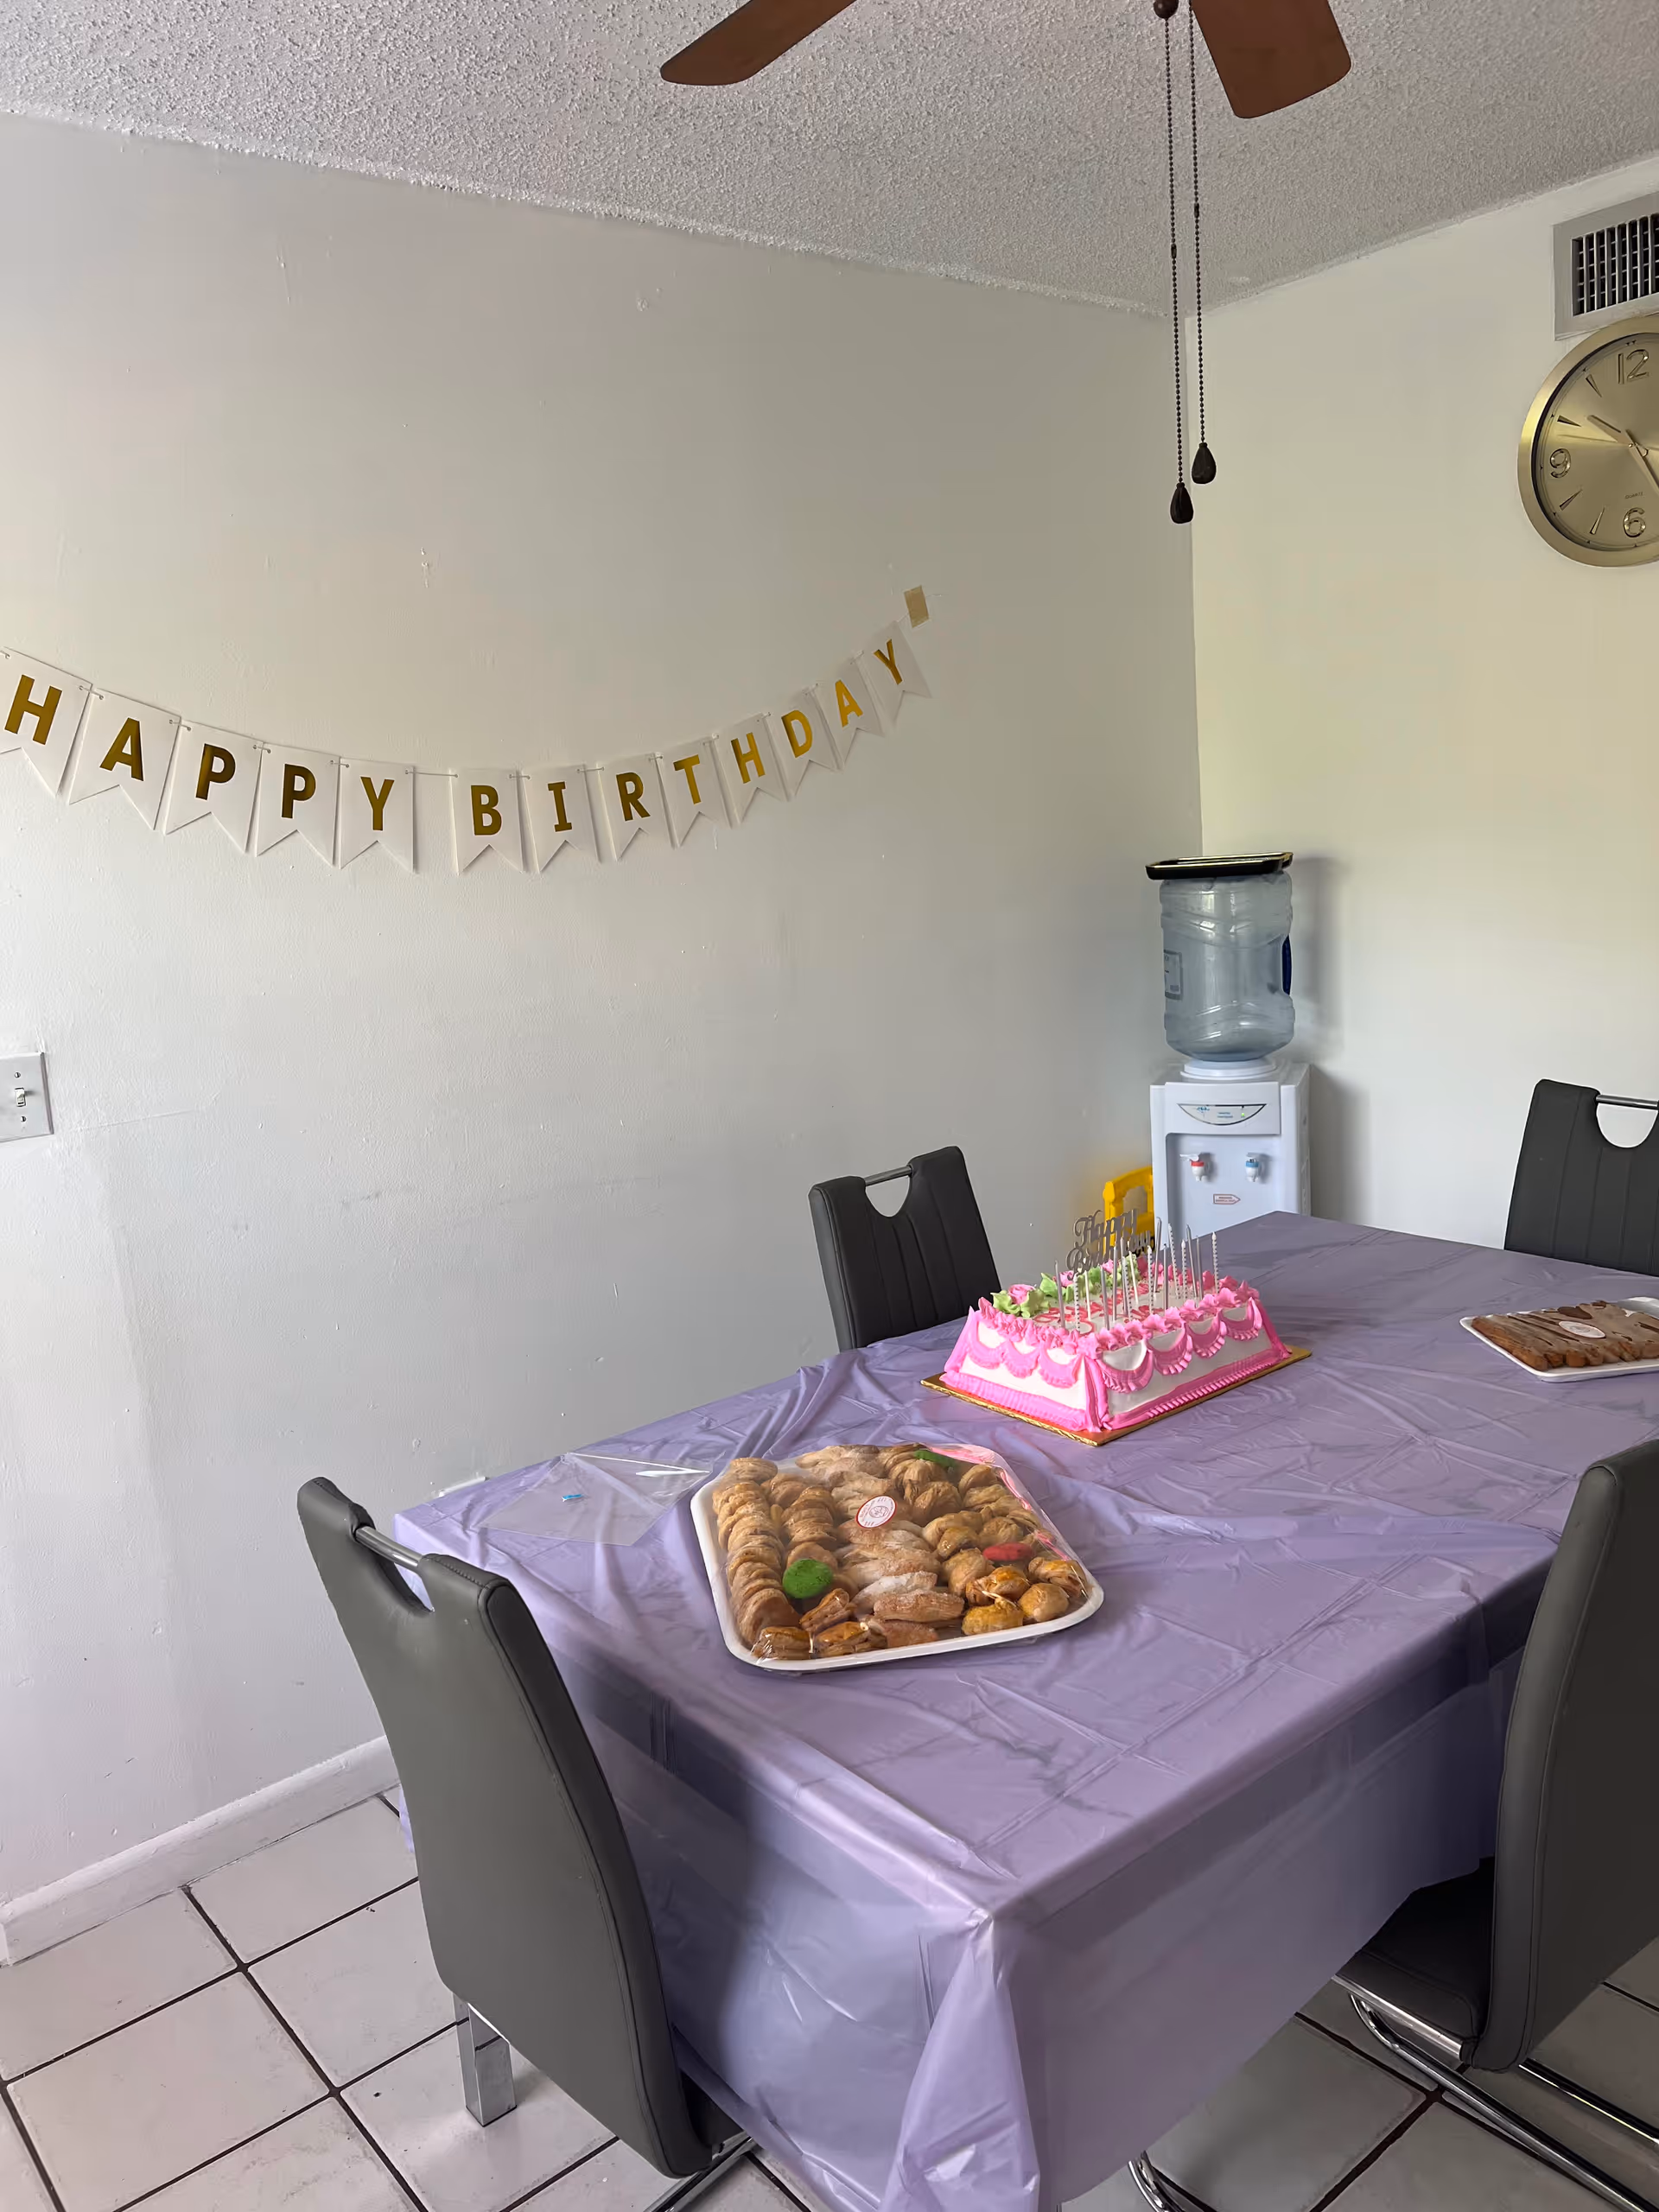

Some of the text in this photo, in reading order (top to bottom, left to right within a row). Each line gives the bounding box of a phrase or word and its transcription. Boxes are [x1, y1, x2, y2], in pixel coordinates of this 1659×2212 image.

[1618, 349, 1649, 385] 12
[1549, 448, 1572, 479] 9
[1623, 507, 1646, 537] 6
[4, 639, 903, 836] HAPPY BIRTHDAY
